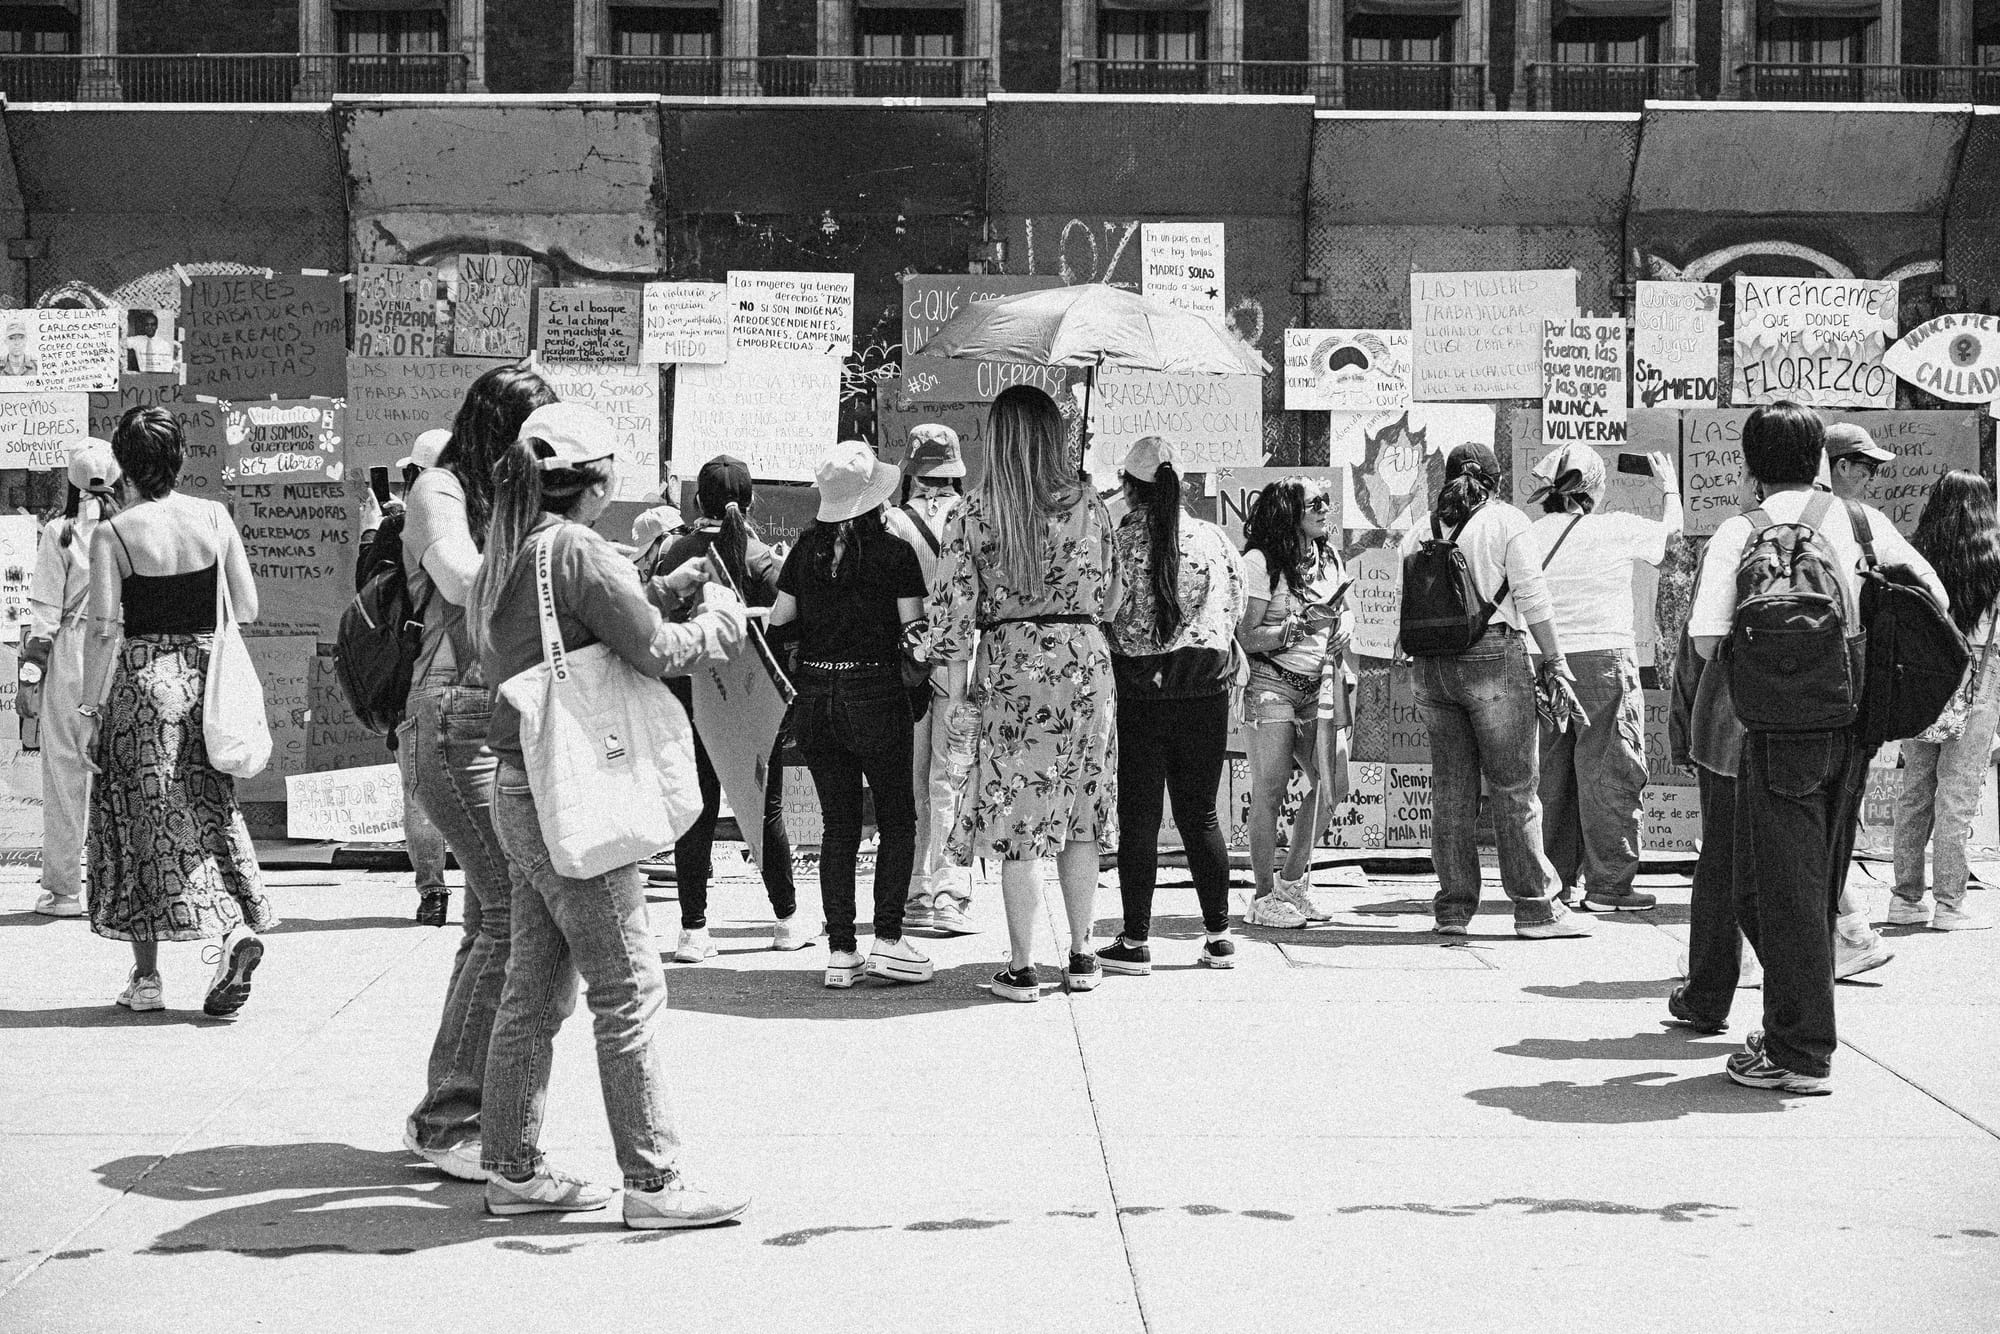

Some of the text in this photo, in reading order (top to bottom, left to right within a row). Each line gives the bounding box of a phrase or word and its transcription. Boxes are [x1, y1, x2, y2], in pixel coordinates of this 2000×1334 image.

[1203, 234, 1211, 244] el
[1151, 247, 1185, 259] que hay
[502, 257, 532, 289] SOY
[1149, 264, 1215, 279] MADRES SOLAS
[189, 279, 295, 310] MUJERES
[756, 279, 848, 294] mujeres ya tienen
[1421, 276, 1539, 300] LAS MUJERES
[708, 290, 721, 301] y
[826, 294, 852, 306] TRANS
[1641, 286, 1696, 311] Quiero
[1744, 281, 1881, 315] Arráncame
[380, 300, 411, 311] VENIA
[549, 300, 626, 322] En el bosque
[739, 300, 790, 314] NO SI SON
[39, 309, 107, 319] EL SE LLAMA
[482, 306, 509, 329] SOY
[548, 314, 609, 327] de la china
[1762, 313, 1851, 329] QUE DONDE
[39, 322, 117, 333] CARLOS CASTILLO
[383, 325, 398, 334] DE
[647, 316, 665, 329] NO
[1692, 316, 1705, 333] a
[98, 330, 113, 338] ME
[190, 322, 302, 348] QUEREMOS
[563, 326, 623, 341] machista se
[796, 330, 852, 344] CAMPESINAS
[1390, 335, 1409, 346] LAS
[1544, 318, 1621, 347] Por las que
[1780, 329, 1866, 344] ME PONGAS
[1903, 314, 1992, 351] NUNCA ME
[38, 342, 73, 352] GOLPEO
[76, 342, 94, 350] CON
[612, 339, 626, 347] se
[618, 346, 629, 356] el
[665, 339, 706, 357] MIEDO
[736, 337, 814, 351] EMPOBRECIDAS
[1651, 333, 1698, 362] jugar
[41, 351, 62, 361] BATE
[189, 341, 316, 365] ESTANCIAS
[1595, 344, 1618, 363] las
[42, 361, 57, 370] POR
[351, 362, 486, 379] LAS MUJERES
[1398, 363, 1411, 374] NO
[1543, 361, 1622, 383] que vienen
[1635, 358, 1662, 382] Sin
[45, 377, 65, 386] PUDE
[1742, 356, 1886, 399] FLOREZCO
[600, 379, 654, 398] SOMOS
[1100, 380, 1233, 407] TRABAJADORAS
[1543, 378, 1608, 401] y las que
[1663, 377, 1718, 401] MIEDO
[355, 407, 430, 422] LUCHANDO
[1102, 409, 1194, 435] LUCHAMOS
[1202, 411, 1238, 433] CON
[23, 418, 80, 436] LIBRES,
[249, 424, 314, 442] ya SOMOS,
[1546, 420, 1627, 442] VOLVERAN
[1690, 419, 1742, 443] LAS
[7, 440, 63, 453] sobrevivir
[354, 433, 377, 447] EL
[1902, 465, 1929, 477] CON
[241, 484, 346, 500] LAS MUJERES
[249, 502, 348, 521] TRABAJADORAS
[1893, 502, 1914, 523] DE
[241, 523, 350, 544] QUEREMOS MAS
[538, 539, 553, 619] HELLO KITTY
[550, 640, 567, 681] HELLO
[1670, 807, 1683, 819] de
[1647, 824, 1672, 834] una
